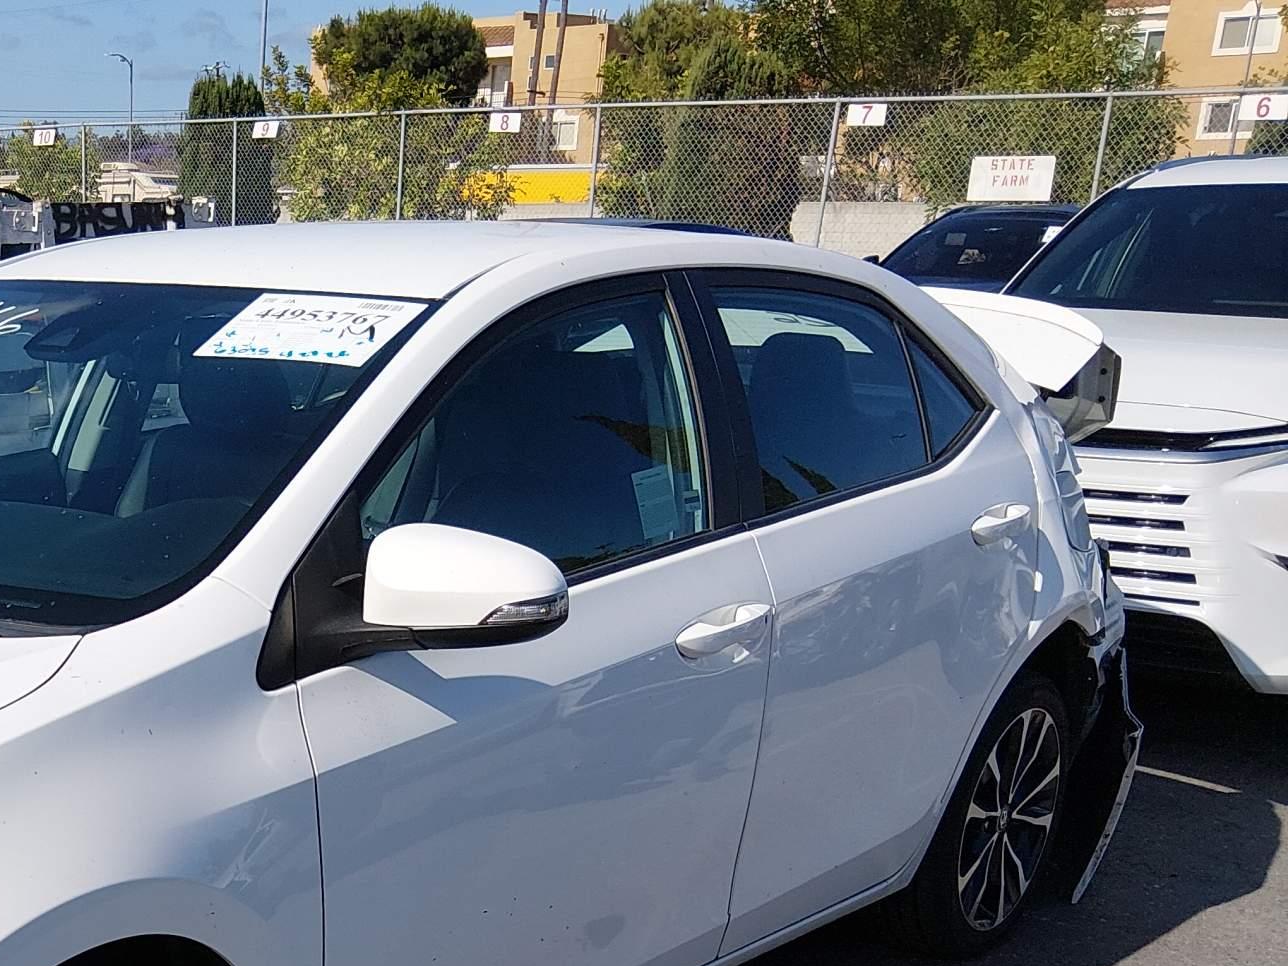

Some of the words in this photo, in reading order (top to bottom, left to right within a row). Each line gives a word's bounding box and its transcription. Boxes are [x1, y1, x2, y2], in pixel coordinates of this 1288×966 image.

[862, 105, 873, 125] 7
[1256, 97, 1272, 118] 6
[260, 122, 270, 137] 9
[499, 114, 510, 131] 8
[37, 131, 51, 144] 10
[990, 158, 1036, 171] STATE
[992, 175, 1030, 188] FARM
[255, 307, 392, 327] 44953767
